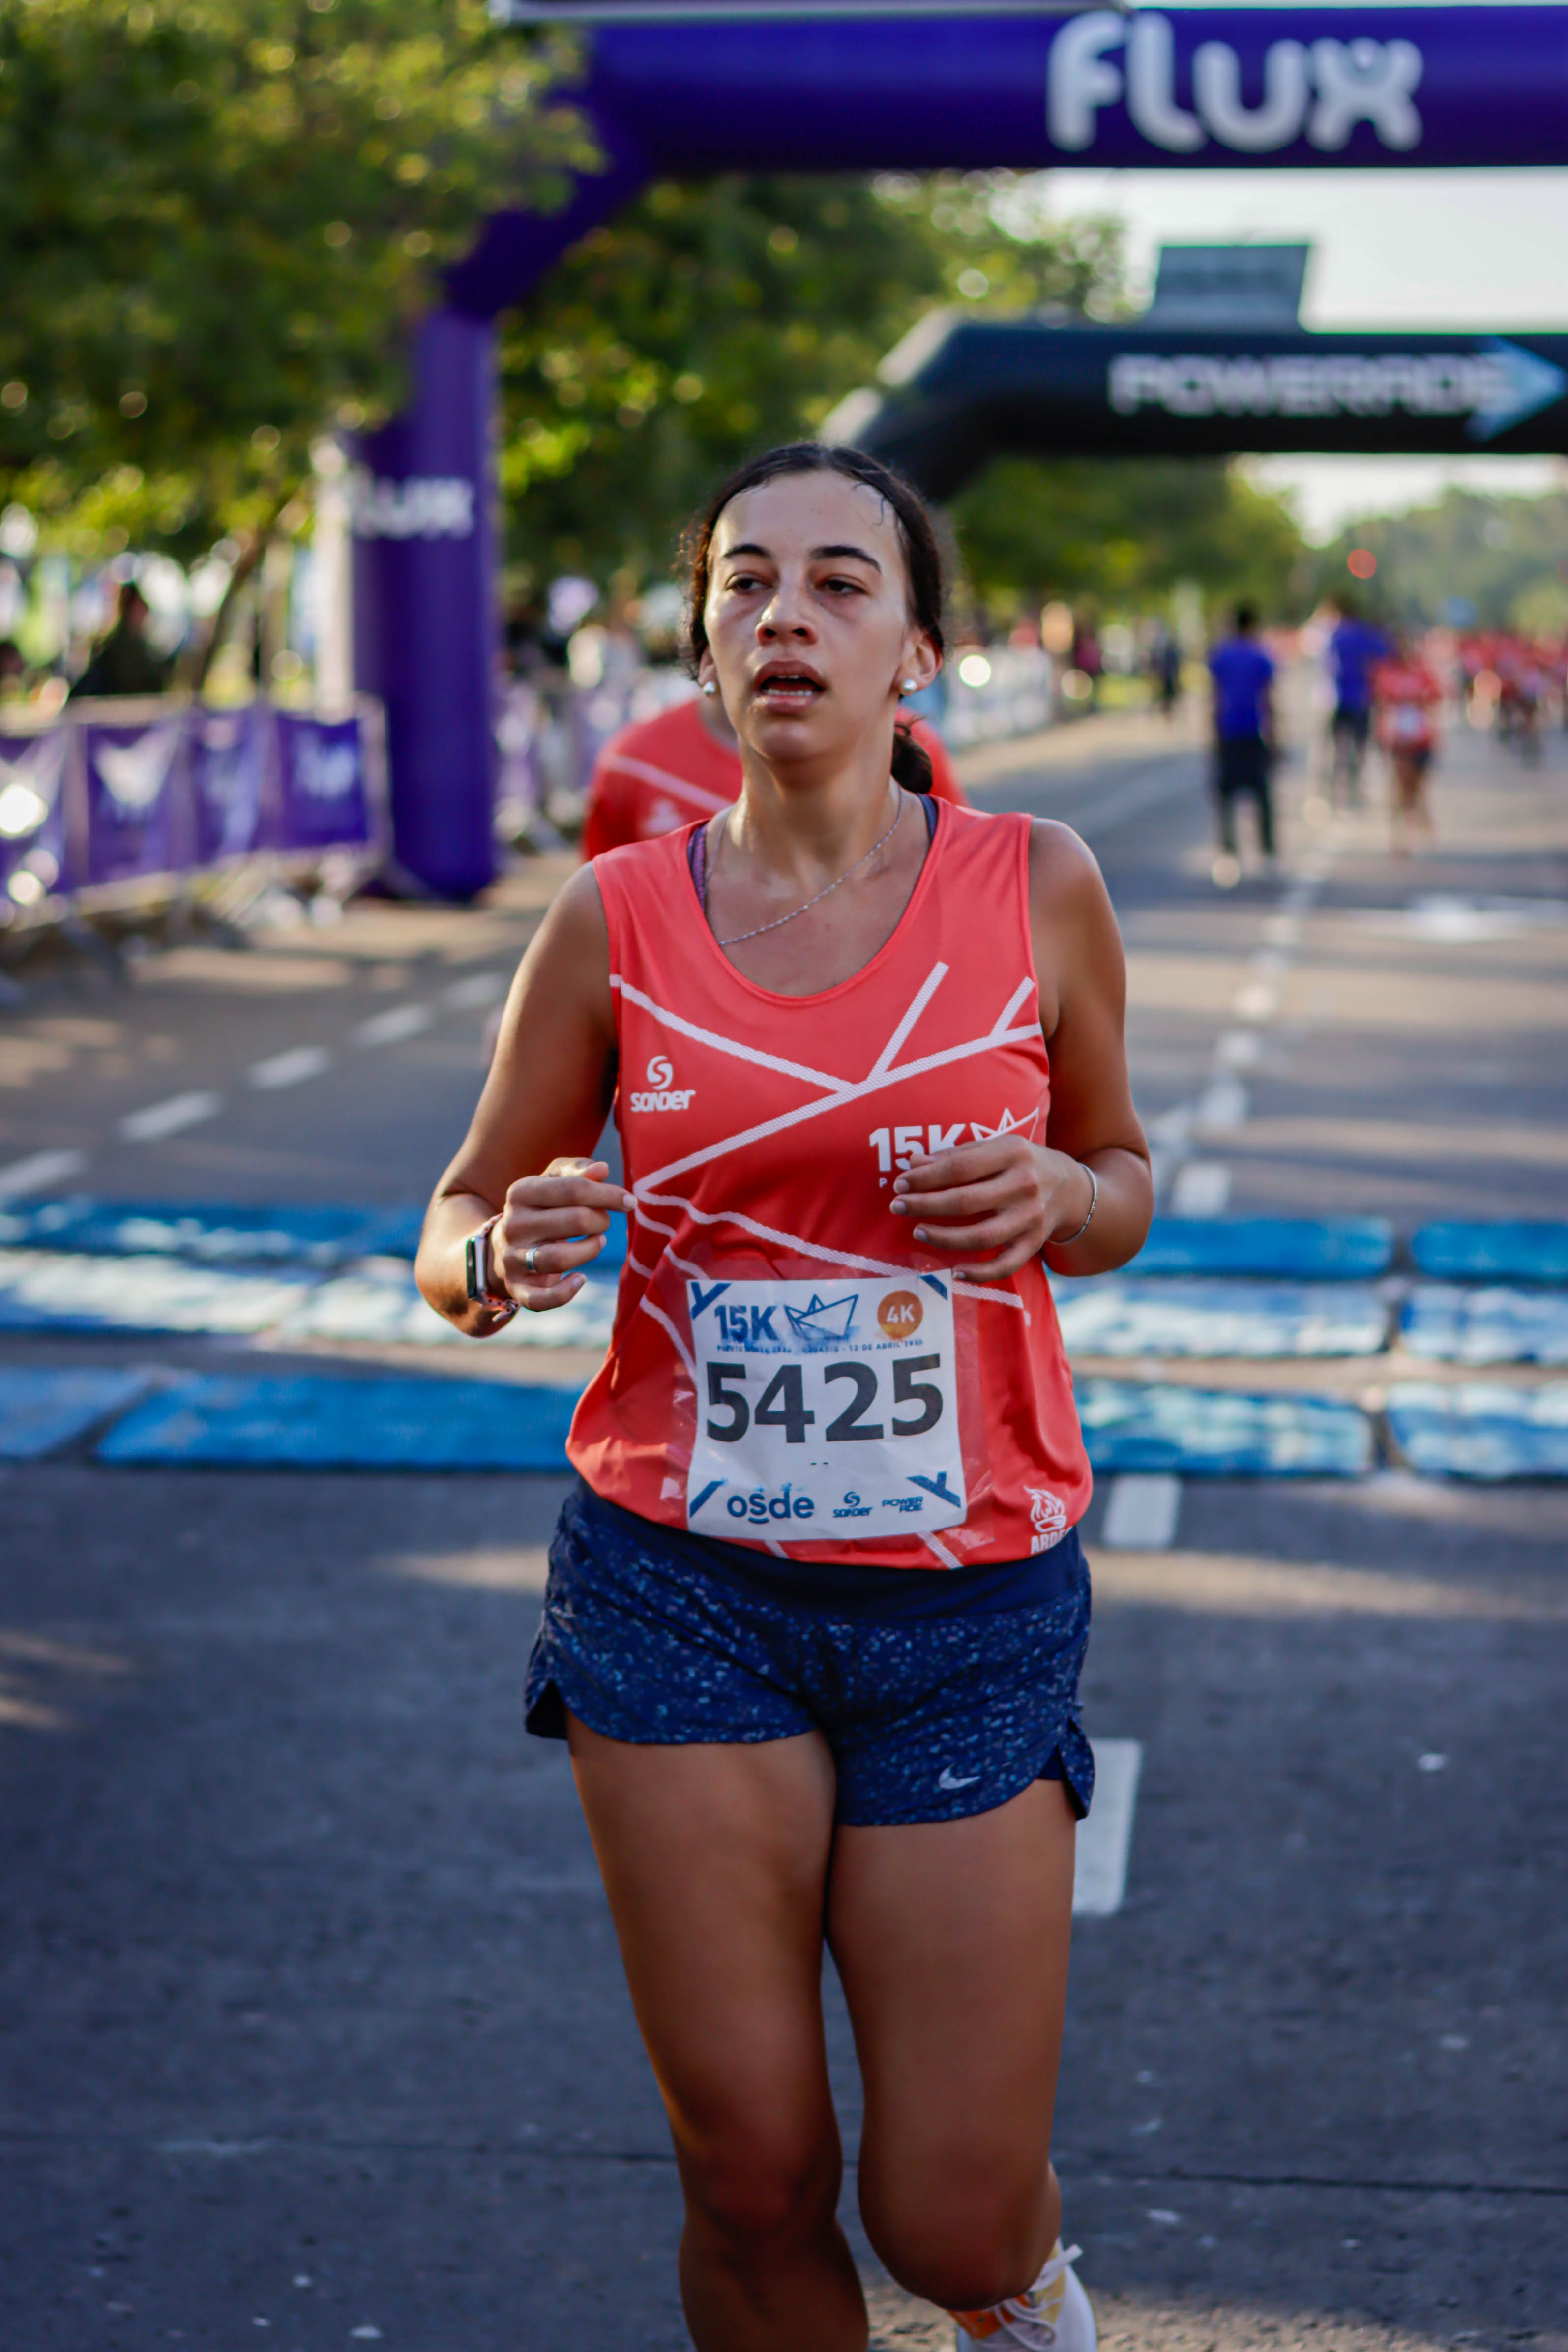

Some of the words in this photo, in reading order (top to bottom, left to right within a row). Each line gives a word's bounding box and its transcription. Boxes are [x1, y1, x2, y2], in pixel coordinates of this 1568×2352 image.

[1108, 353, 1517, 417] POWERADE
[869, 1123, 966, 1172] 15K
[714, 1305, 779, 1341] 15K
[886, 1304, 915, 1323] 4K
[877, 1341, 900, 1350] ABRIL
[707, 1353, 943, 1443] 5425
[727, 1488, 815, 1520] osde
[882, 1496, 923, 1507] POWER
[1031, 1526, 1073, 1554] ARDE
